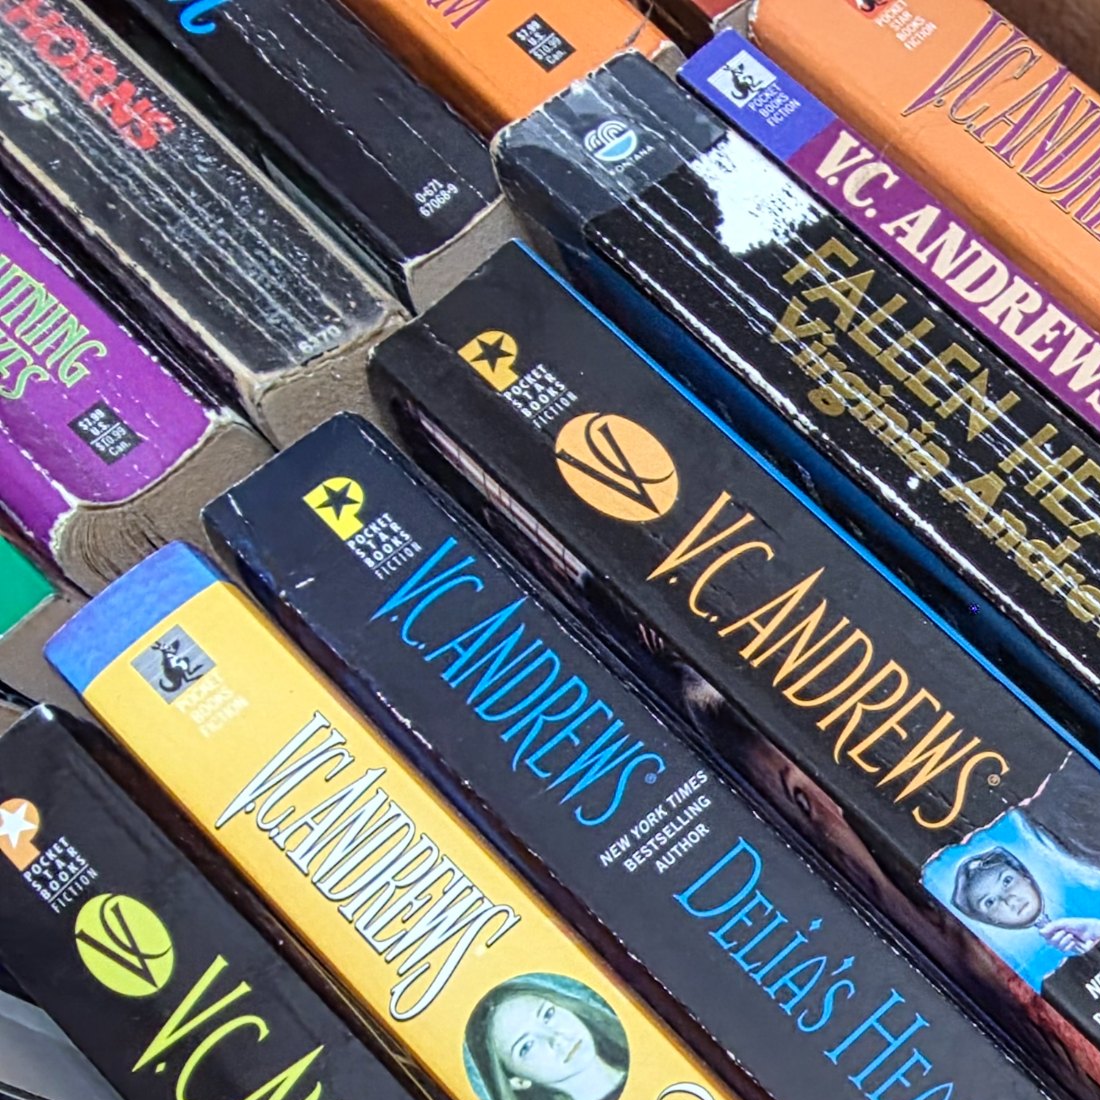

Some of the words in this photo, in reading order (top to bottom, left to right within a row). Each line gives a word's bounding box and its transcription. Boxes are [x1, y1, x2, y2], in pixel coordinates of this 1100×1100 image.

[903, 22, 938, 51] FICTION
[747, 82, 782, 112] POCKET
[758, 92, 789, 118] BOOKS
[766, 98, 801, 127] FICTION
[415, 179, 444, 203] 0-671
[815, 129, 899, 218] V.C.
[782, 236, 1020, 443] FALLEN
[502, 363, 547, 402] POCKET
[513, 374, 557, 408] STAR
[520, 380, 566, 418] BOOKS
[532, 390, 579, 429] FICTION
[346, 512, 393, 550] POCKET
[355, 521, 402, 557] STAR
[363, 529, 411, 568] BOOKS
[374, 541, 423, 580] FICTION
[599, 834, 632, 867] NEW
[630, 804, 668, 841] YORK
[666, 770, 709, 809] TIMES
[623, 795, 712, 872] BESTSELLING
[23, 836, 69, 882] POCKET
[31, 845, 78, 891] STAR
[655, 823, 710, 874] AUTHOR
[40, 855, 87, 900] BOOKS
[51, 867, 99, 914] FICTION
